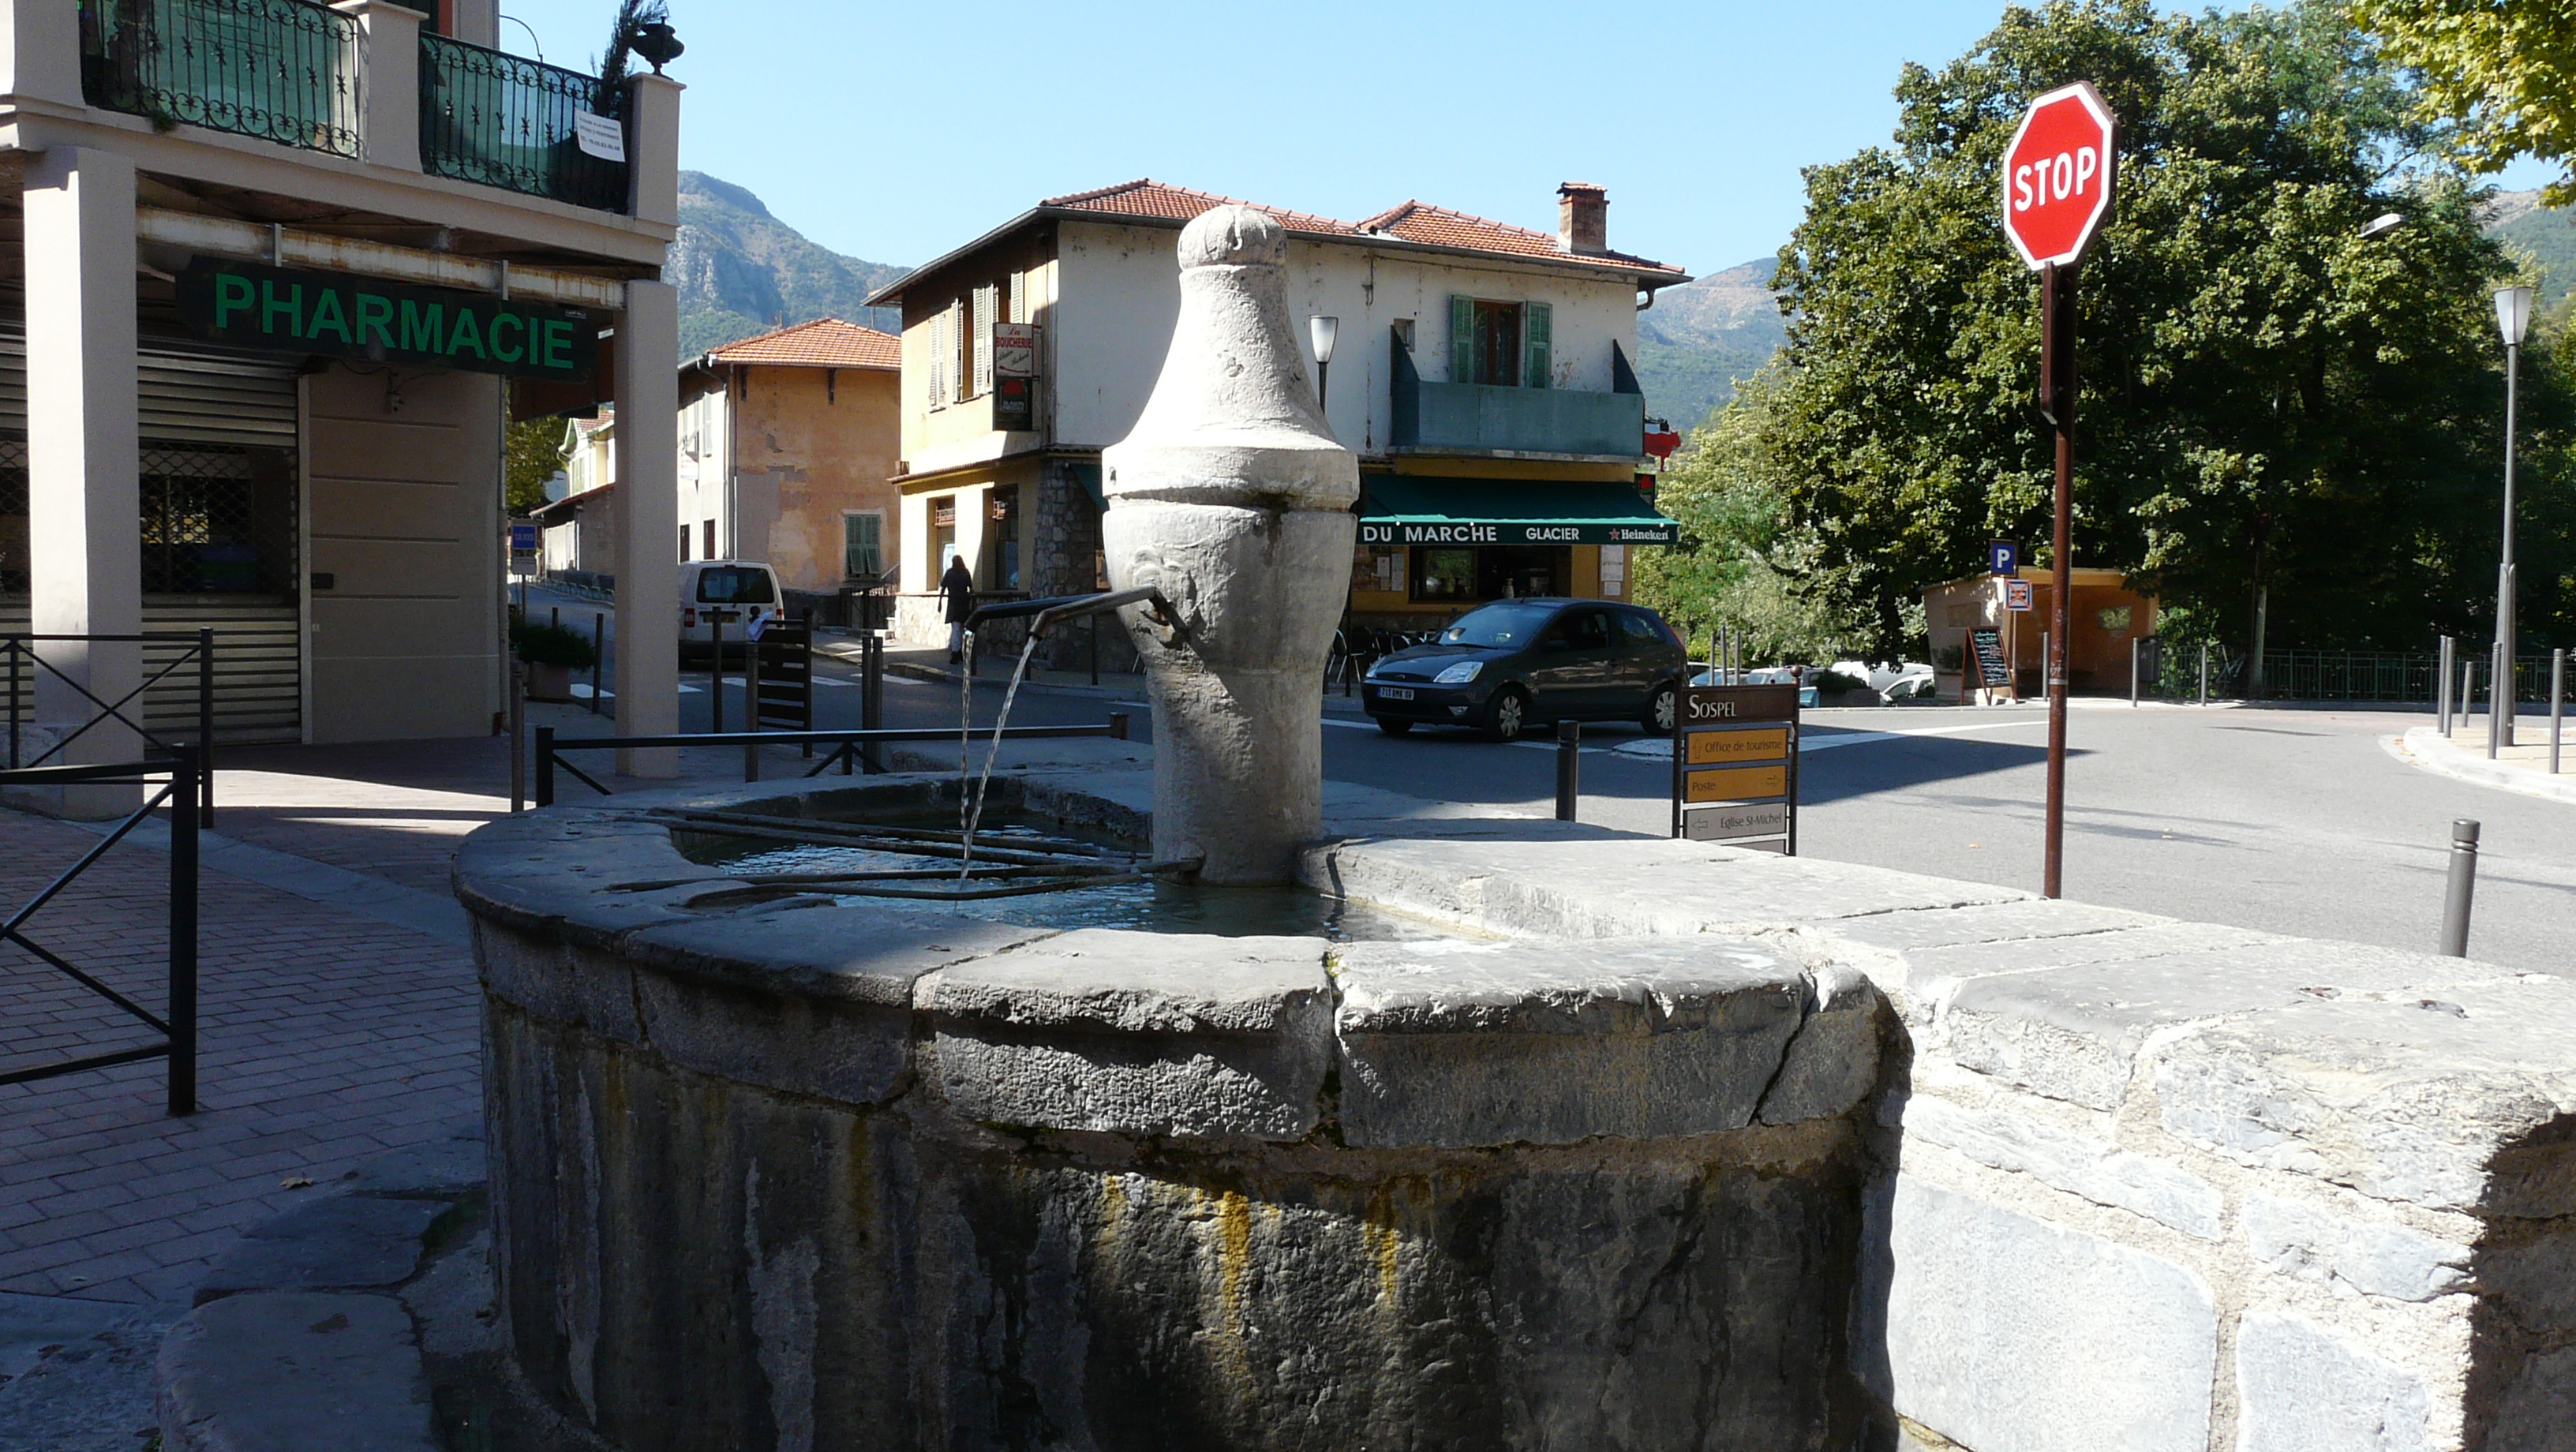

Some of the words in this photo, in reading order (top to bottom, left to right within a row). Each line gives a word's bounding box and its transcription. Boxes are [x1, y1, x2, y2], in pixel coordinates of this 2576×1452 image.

[2014, 146, 2096, 211] STOP
[215, 273, 575, 369] PHARMACIE
[995, 336, 1033, 349] BOUCHERIE
[515, 533, 534, 541] TAXIS
[1363, 526, 1392, 542] DU
[1405, 526, 1497, 542] MARCHE
[1526, 527, 1579, 541] GLACIER
[1621, 529, 1669, 541] Heineken
[1997, 548, 2010, 568] P
[1705, 742, 1731, 753] Office
[1734, 741, 1744, 750] de
[1747, 740, 1783, 750] tourisme
[1692, 781, 1716, 791] Poste
[1746, 812, 1782, 826] St-Michel
